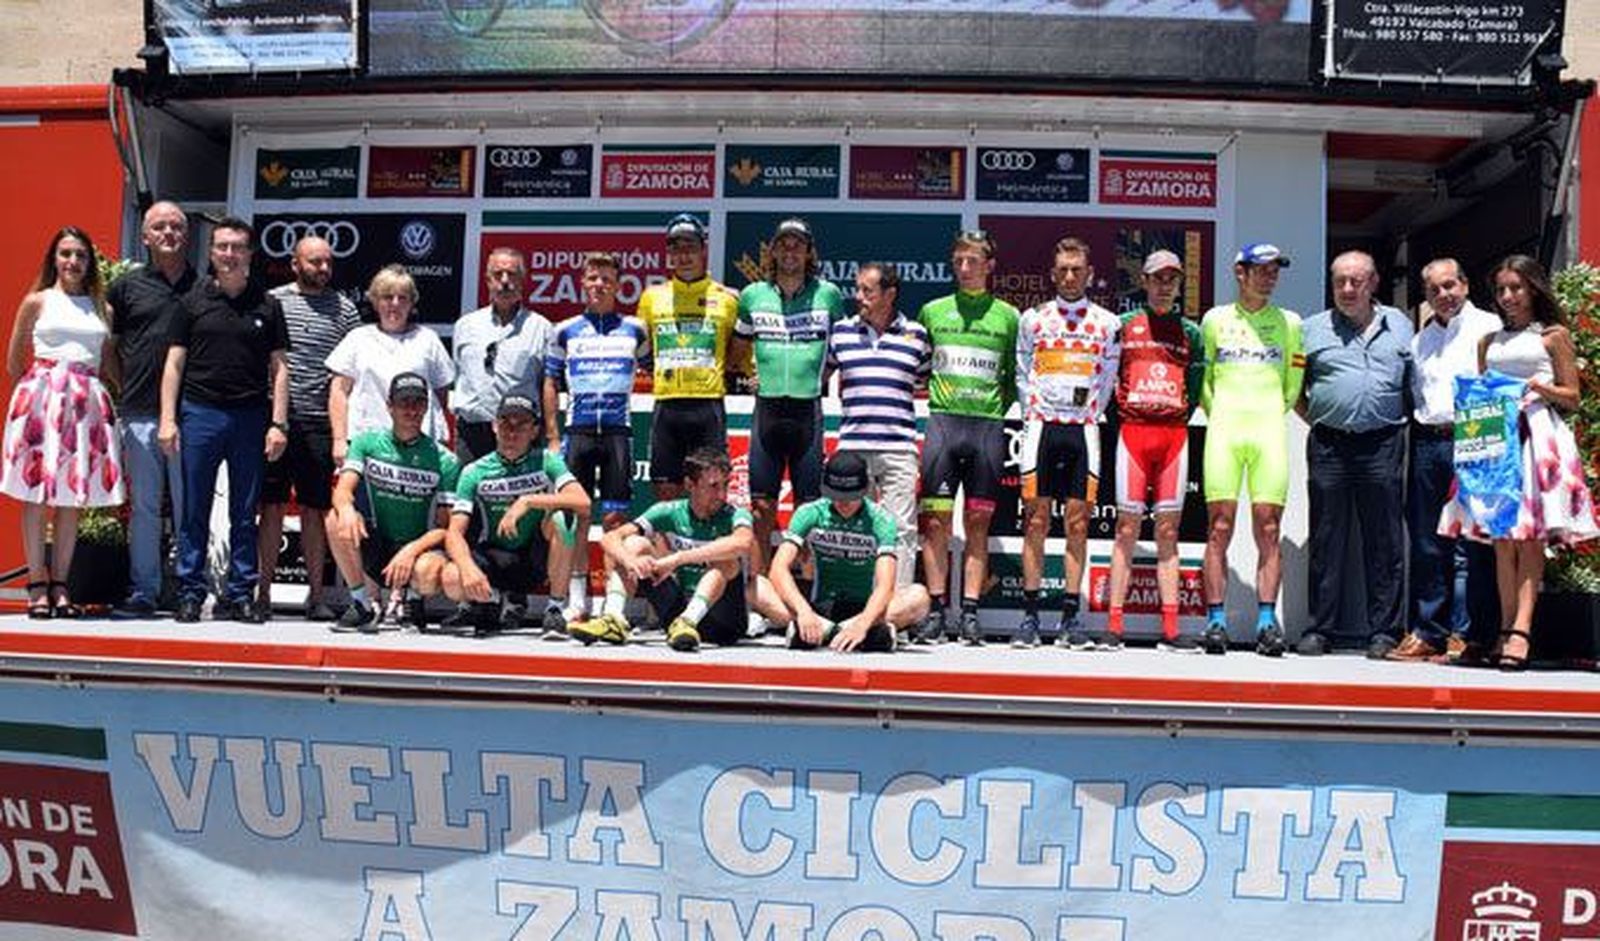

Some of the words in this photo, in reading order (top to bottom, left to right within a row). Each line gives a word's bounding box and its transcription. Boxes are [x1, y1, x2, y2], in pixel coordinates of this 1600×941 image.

[1502, 6, 1523, 17] 273
[1400, 30, 1420, 41] 557
[1500, 32, 1520, 43] 512
[625, 174, 710, 190] ZAMORA
[1126, 180, 1211, 199] ZAMORA
[993, 274, 1047, 292] HOTEL
[0, 798, 31, 829] N
[41, 801, 98, 836] DE
[132, 731, 664, 868] VUELTA
[700, 765, 1407, 905] CICLISTA
[0, 838, 114, 899] RA
[355, 866, 436, 941] A
